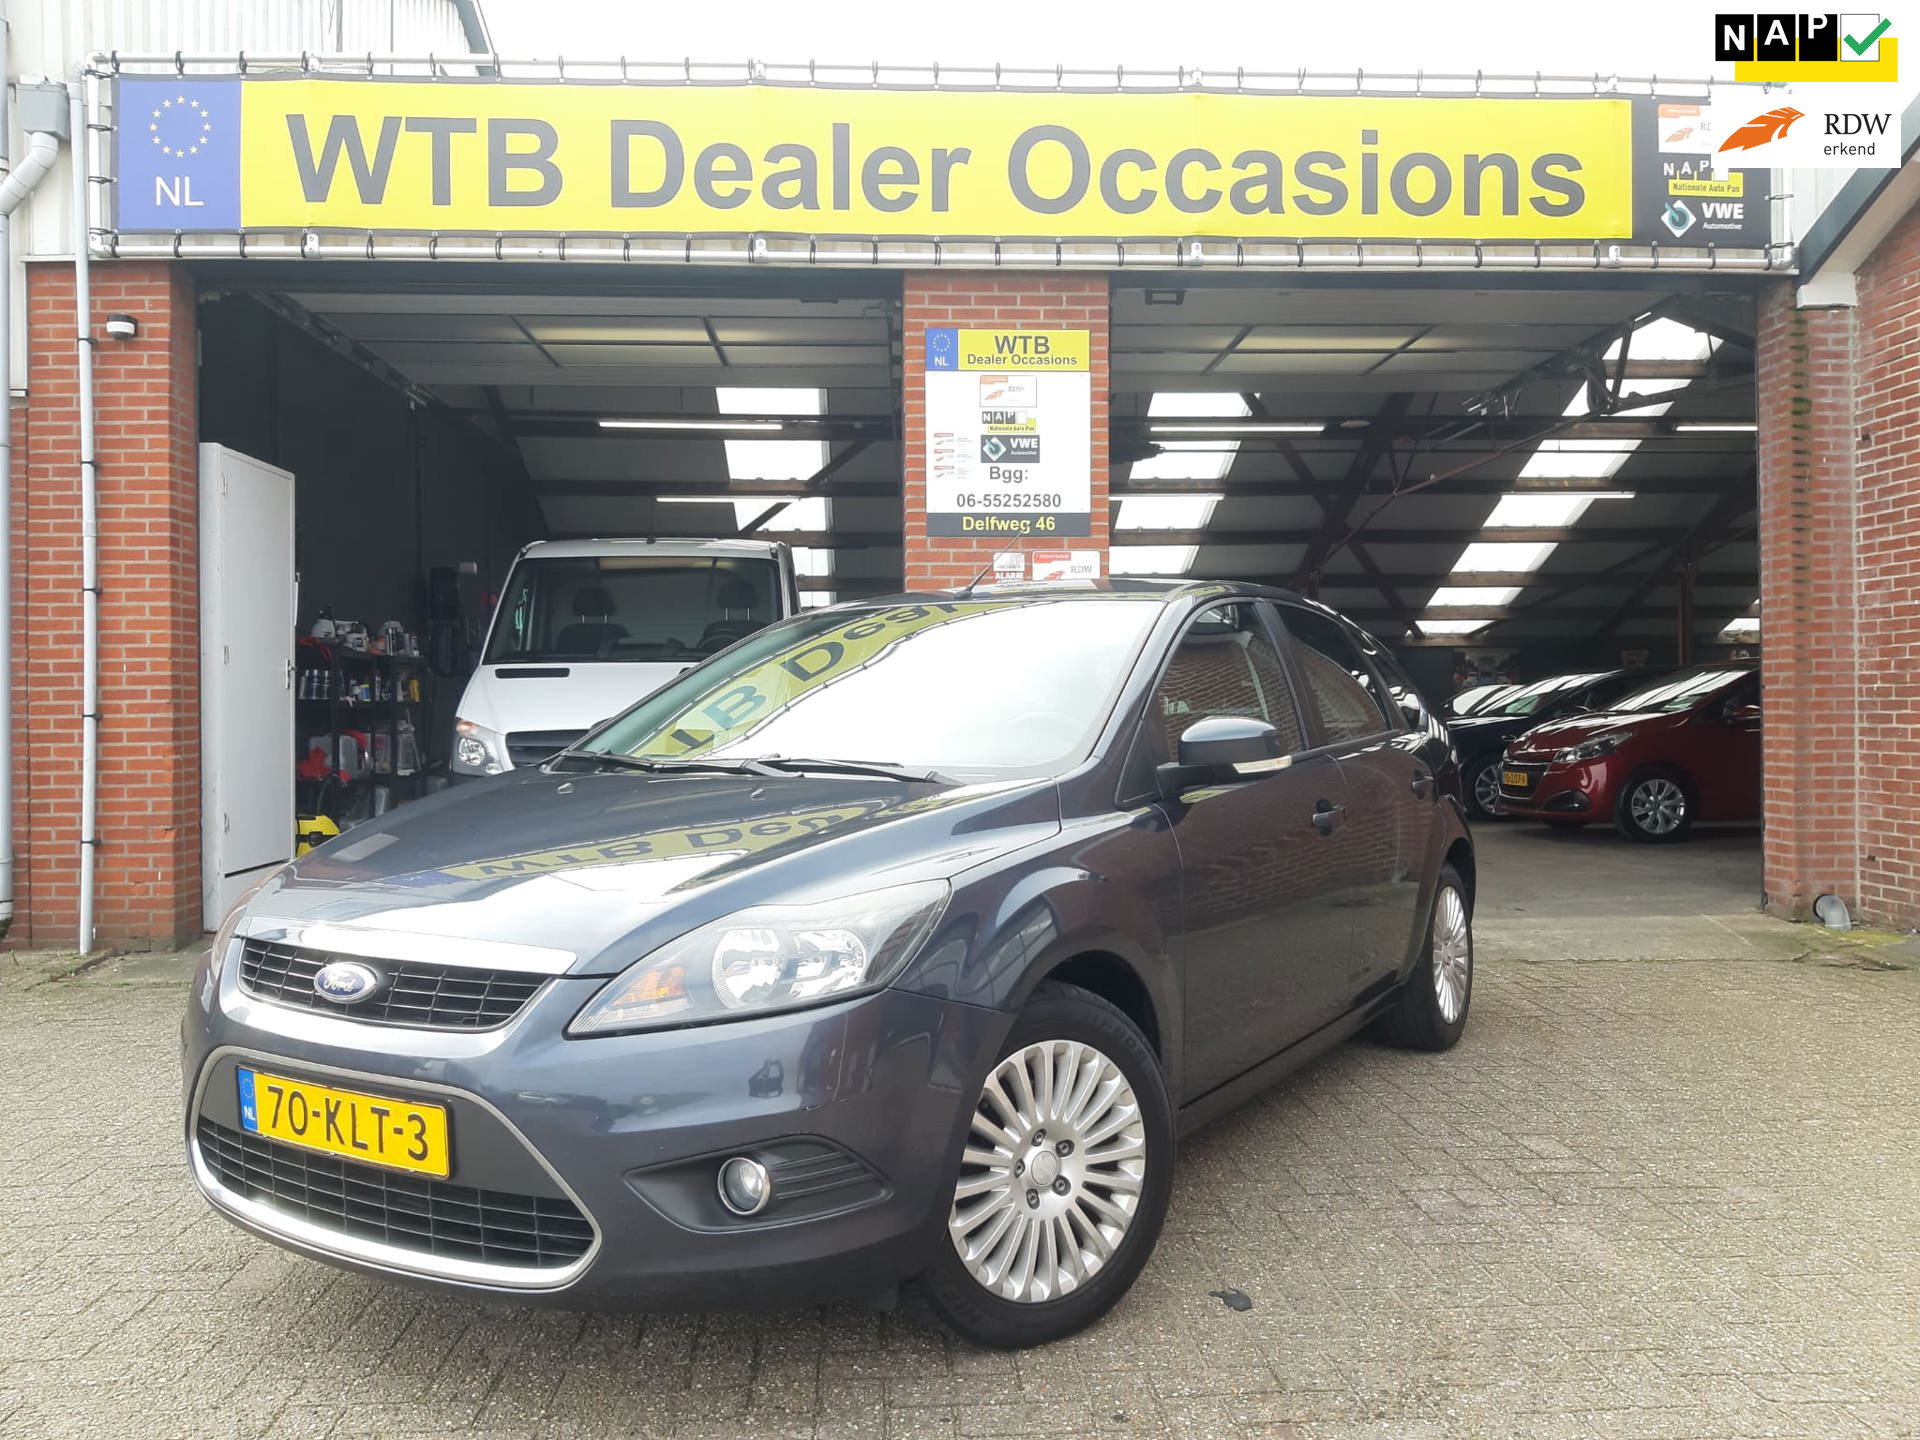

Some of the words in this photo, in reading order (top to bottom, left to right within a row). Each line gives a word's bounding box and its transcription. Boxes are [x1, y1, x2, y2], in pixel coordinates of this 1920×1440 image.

[286, 114, 563, 207] WTB
[611, 120, 972, 213] Dealer
[1008, 125, 1586, 217] Occasions
[155, 176, 204, 207] NL
[1708, 183, 1725, 192] Auto
[1701, 202, 1744, 219] VWE
[1702, 221, 1742, 230] Automotive
[994, 335, 1050, 354] WTB
[934, 356, 949, 366] NL
[967, 354, 1008, 365] Dealer
[1011, 354, 1078, 366] Occasions
[1010, 438, 1039, 449] VWE
[989, 465, 1028, 484] Bgg:
[956, 493, 1062, 508] 06-55252580
[962, 516, 1031, 534] Delfweg
[1035, 516, 1056, 531] 46
[244, 1105, 256, 1122] NL
[267, 1086, 429, 1161] 70-KLT-3
